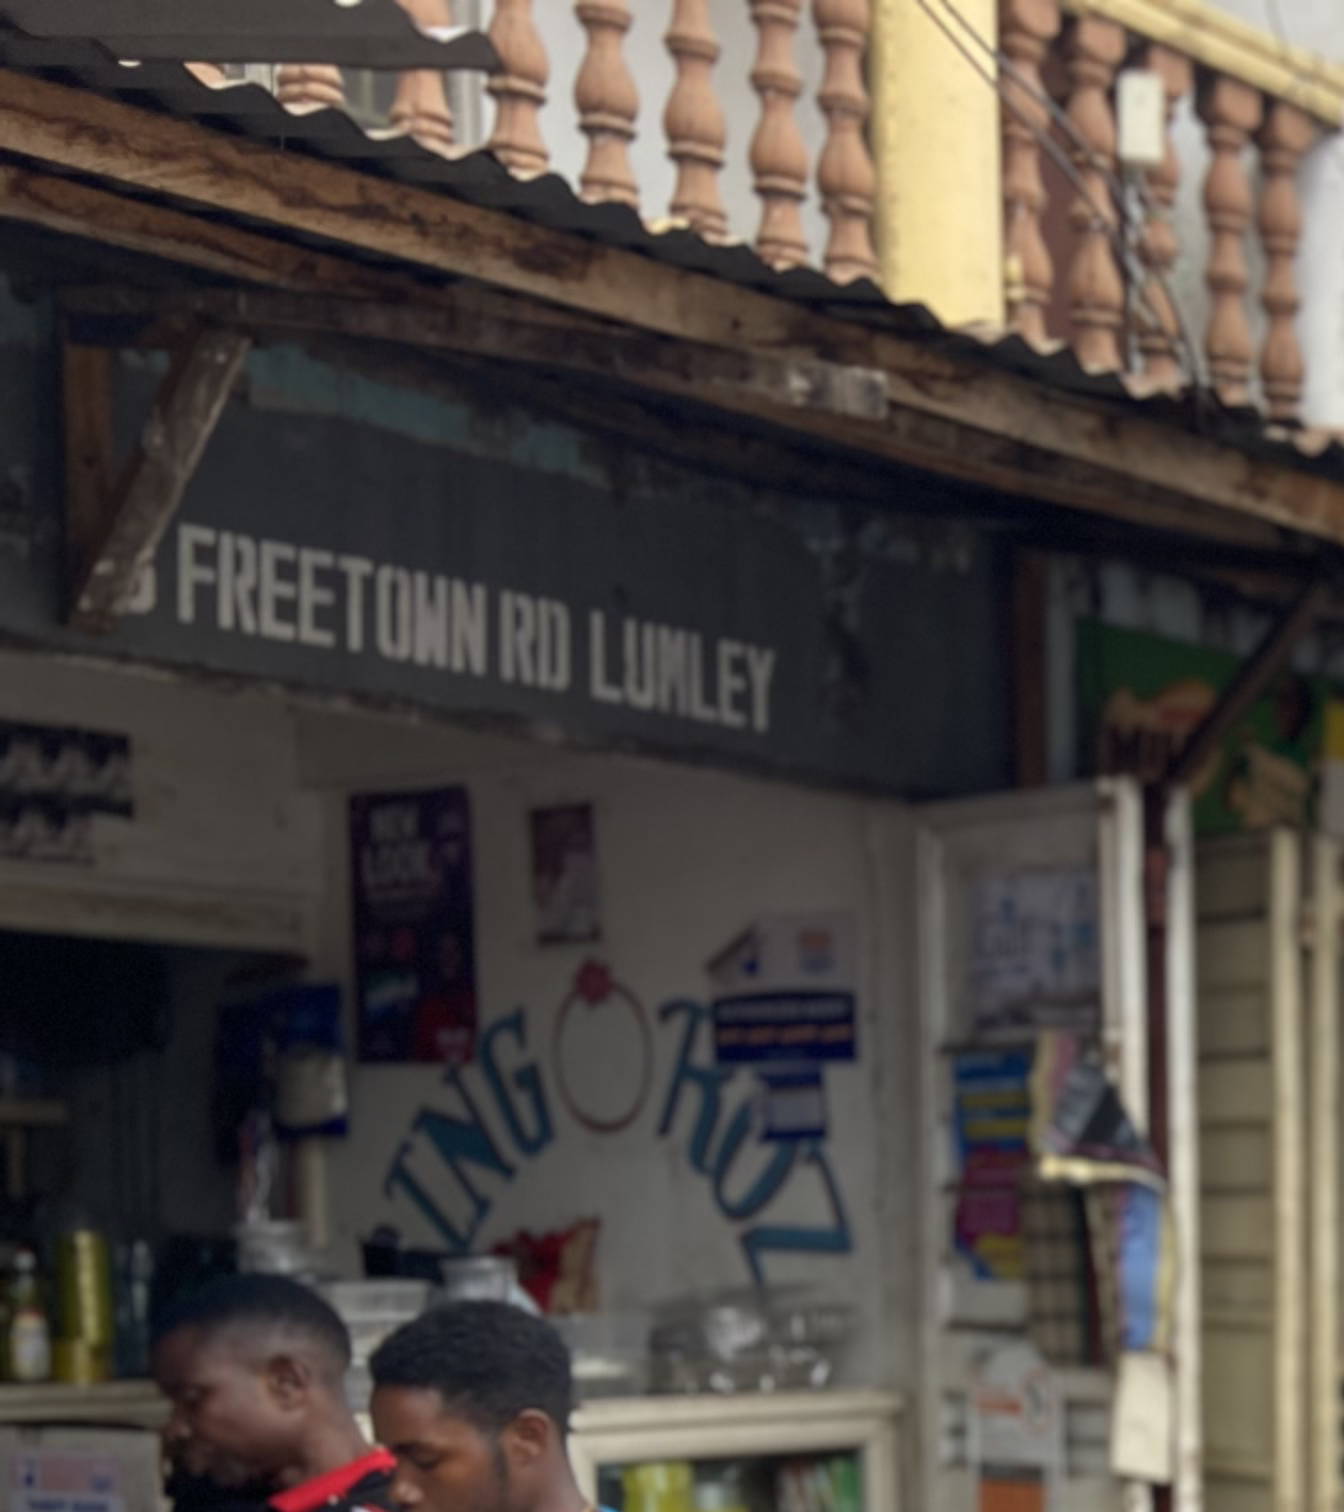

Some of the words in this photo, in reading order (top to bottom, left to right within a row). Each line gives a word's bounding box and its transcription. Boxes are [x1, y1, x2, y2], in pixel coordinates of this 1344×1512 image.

[176, 523, 487, 678] FREETOWN
[499, 590, 572, 692] RD
[590, 610, 777, 734] LUMLEY
